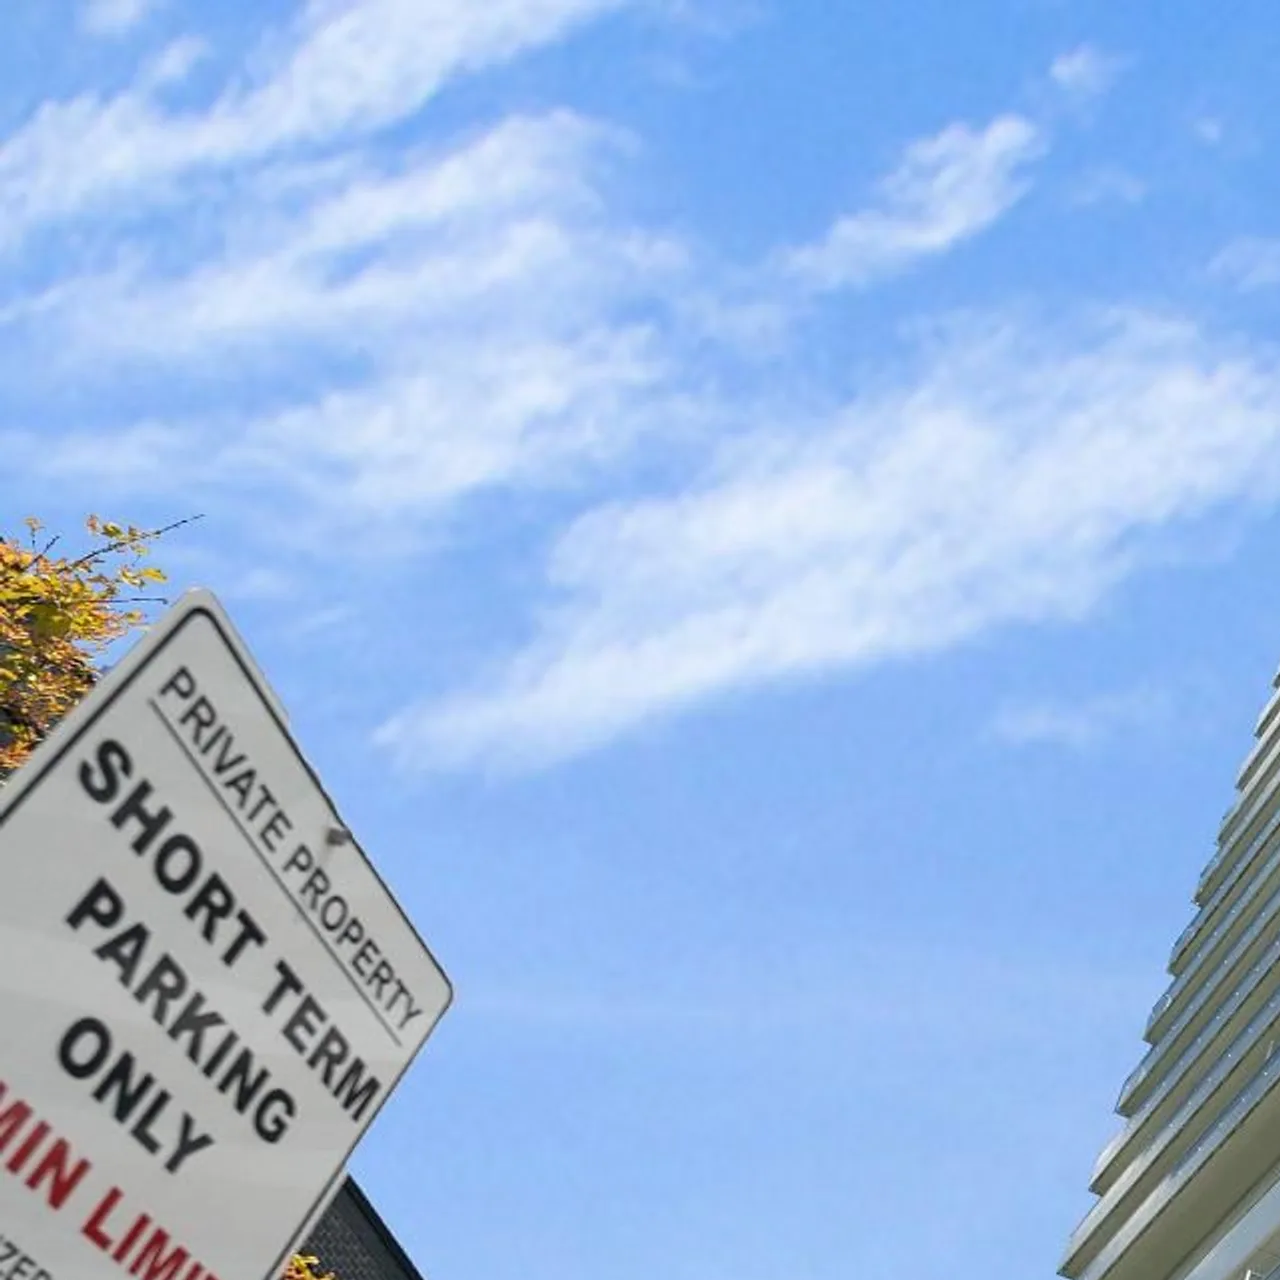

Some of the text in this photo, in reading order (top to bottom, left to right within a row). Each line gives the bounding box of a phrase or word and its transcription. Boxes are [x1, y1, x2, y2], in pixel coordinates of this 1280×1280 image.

[77, 738, 381, 1122] SHORT TERM
[160, 666, 423, 1030] PRIVATE PROPERTY
[57, 1016, 214, 1174] ONLY
[65, 877, 297, 1144] PARKING
